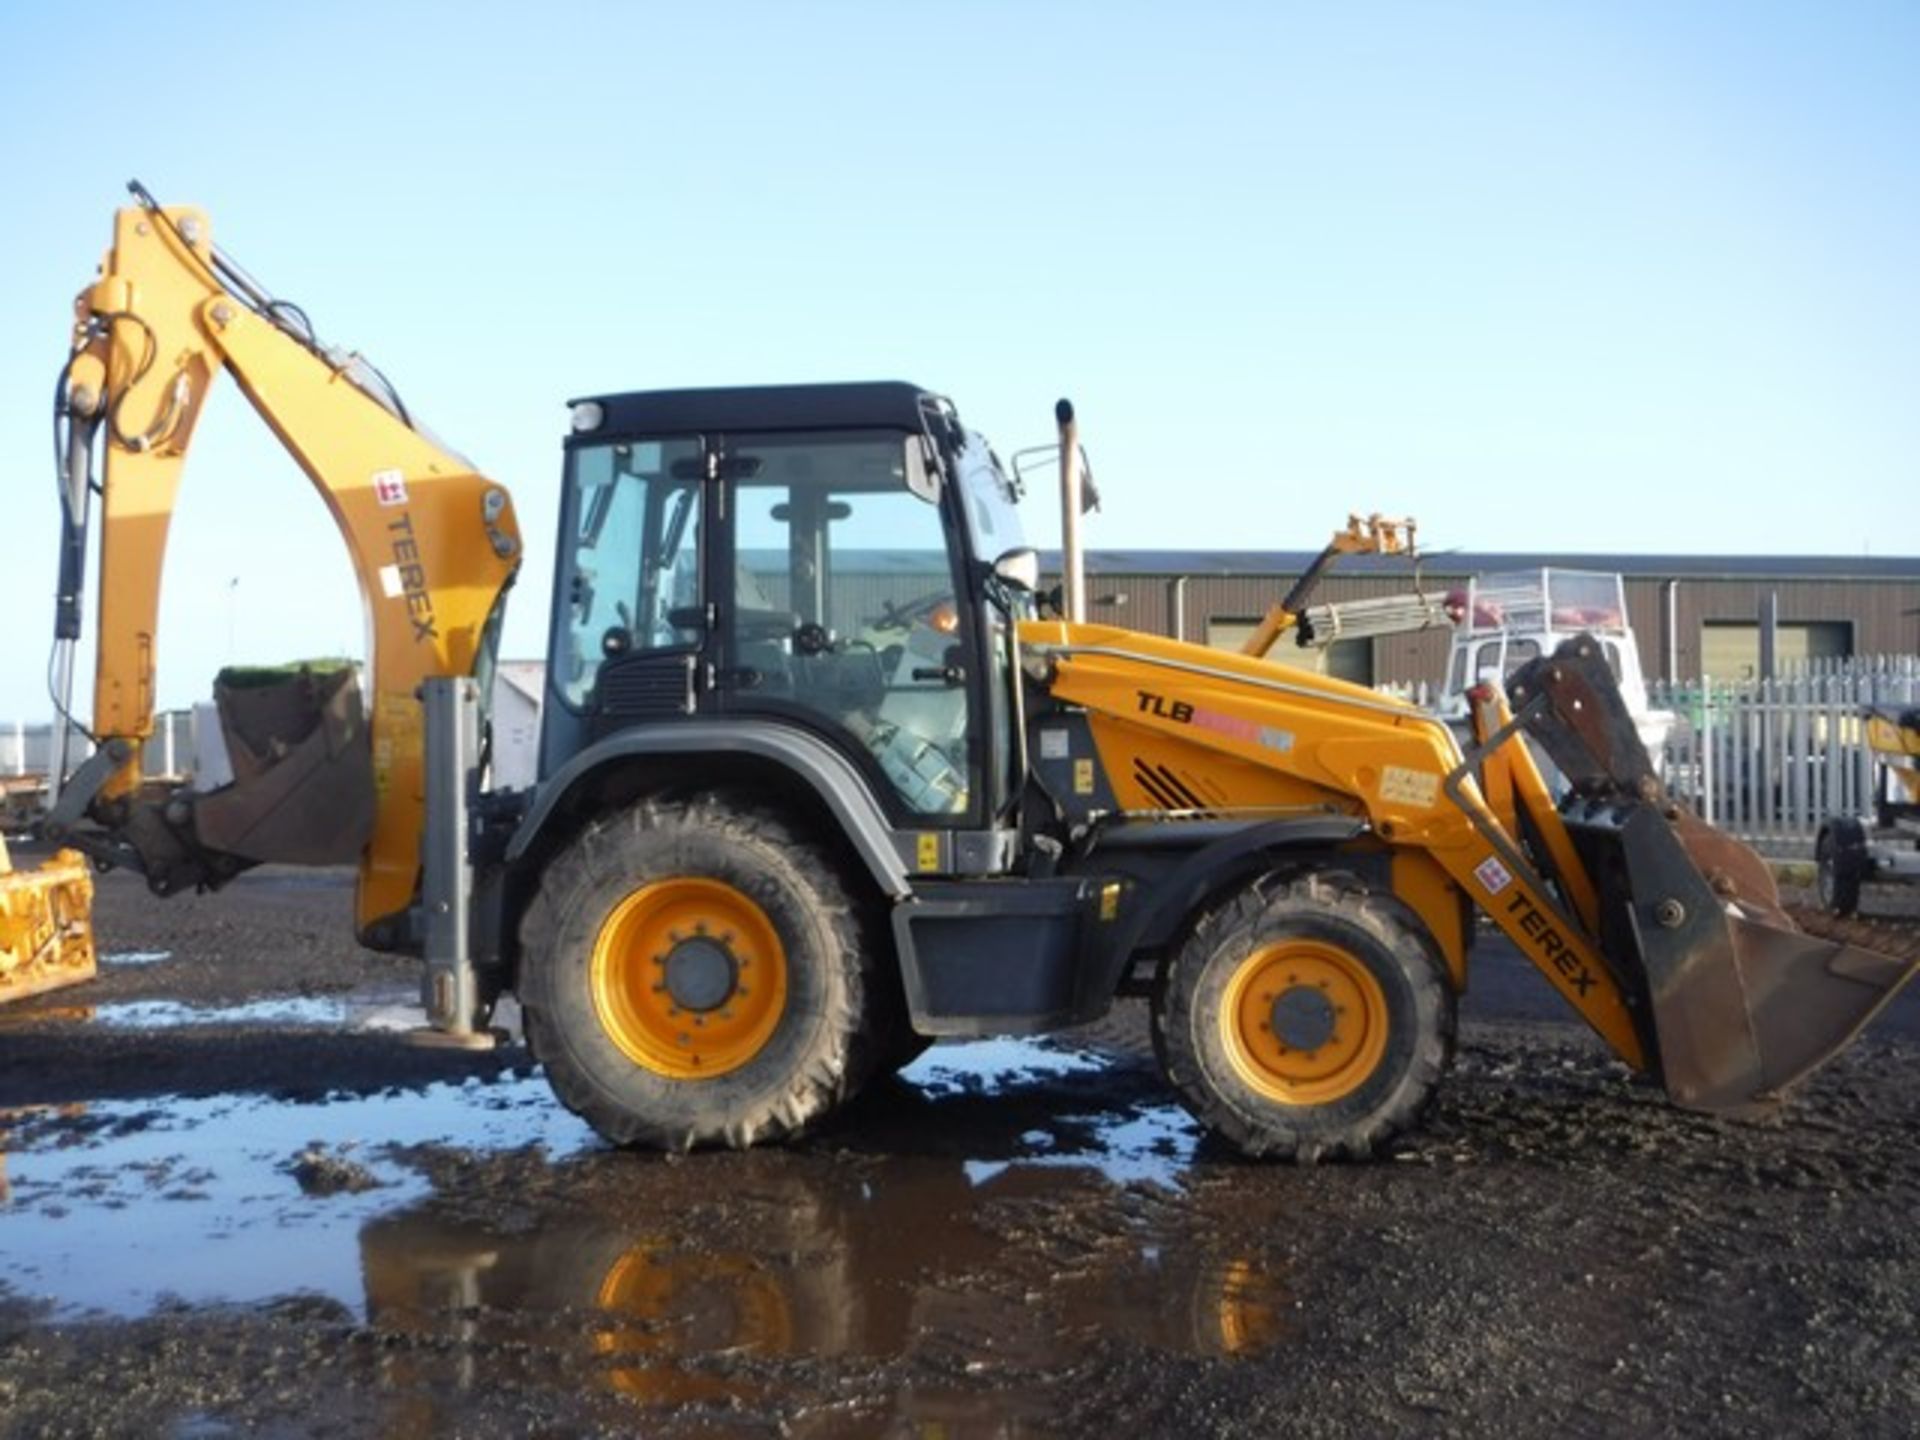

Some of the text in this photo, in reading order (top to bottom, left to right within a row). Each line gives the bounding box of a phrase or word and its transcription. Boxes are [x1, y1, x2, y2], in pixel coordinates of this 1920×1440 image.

[388, 512, 438, 643] TEREX
[1137, 690, 1196, 724] TLB
[1507, 891, 1598, 997] TEREX
